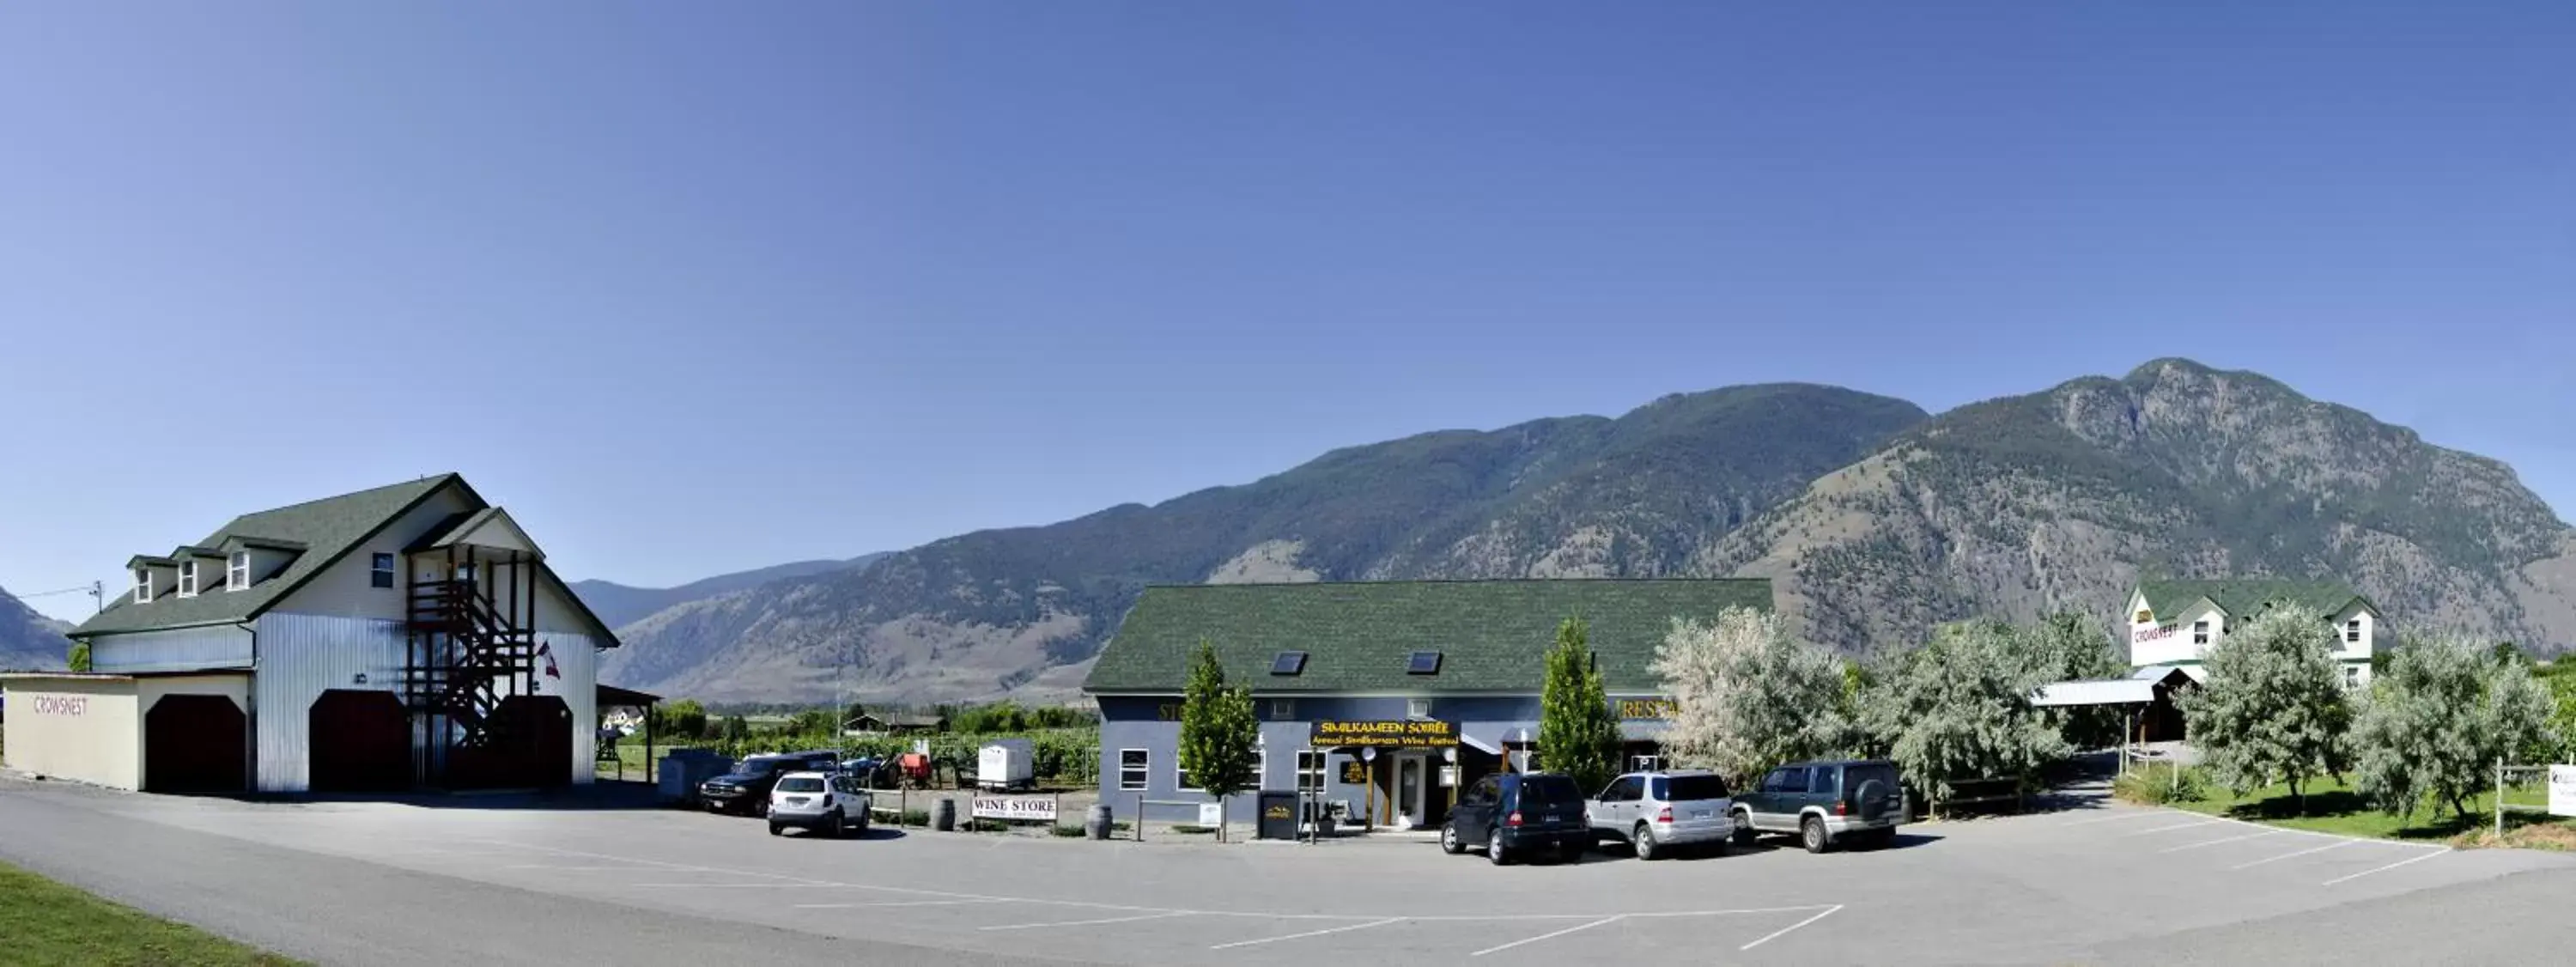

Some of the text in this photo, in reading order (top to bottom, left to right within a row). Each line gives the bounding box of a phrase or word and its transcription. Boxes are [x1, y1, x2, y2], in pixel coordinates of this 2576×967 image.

[34, 696, 88, 715] CROWSNEST
[1321, 721, 1449, 733] SIMILKAMEEN SOIRÉE
[1313, 735, 1459, 745] Annual Similkameen Wine Festival
[975, 799, 1054, 812] WINE STORE
